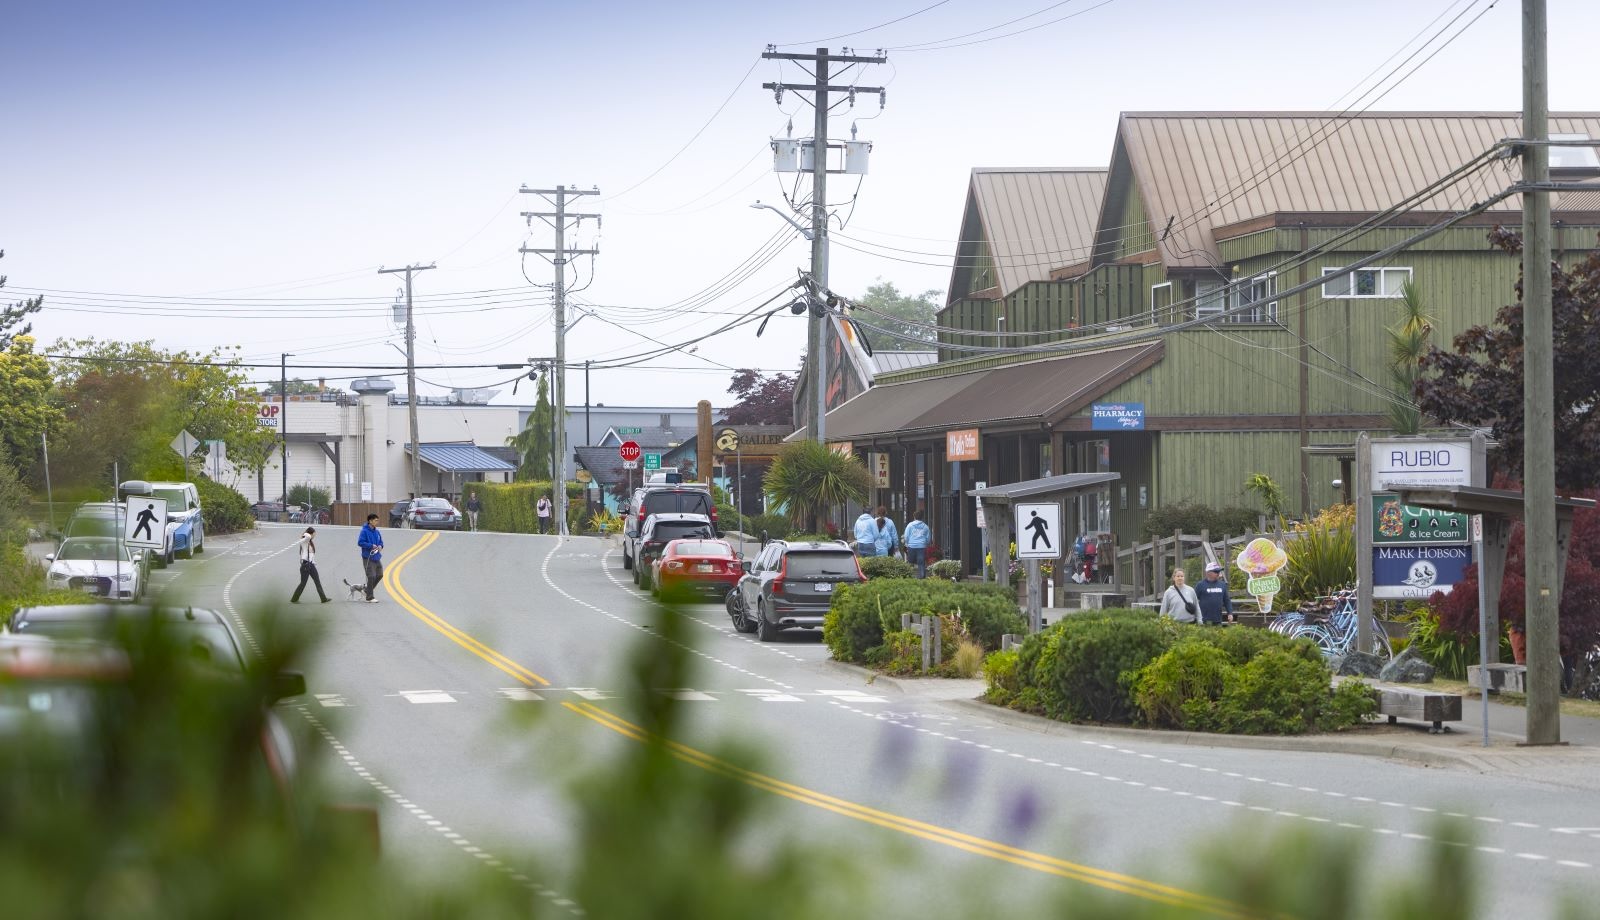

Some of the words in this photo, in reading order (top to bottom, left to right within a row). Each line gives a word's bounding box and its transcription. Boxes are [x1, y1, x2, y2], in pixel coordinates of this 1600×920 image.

[258, 418, 277, 426] STORE
[621, 447, 639, 456] STOP
[1391, 450, 1451, 467] RUBIO
[879, 454, 887, 478] ATM
[1411, 518, 1458, 528] JAR
[1409, 530, 1417, 538] &
[1419, 530, 1431, 538] Ice
[1433, 529, 1460, 538] Cream
[1379, 547, 1415, 559] MARK
[1418, 546, 1466, 559] HOBSON
[1402, 588, 1440, 597] GALLE
